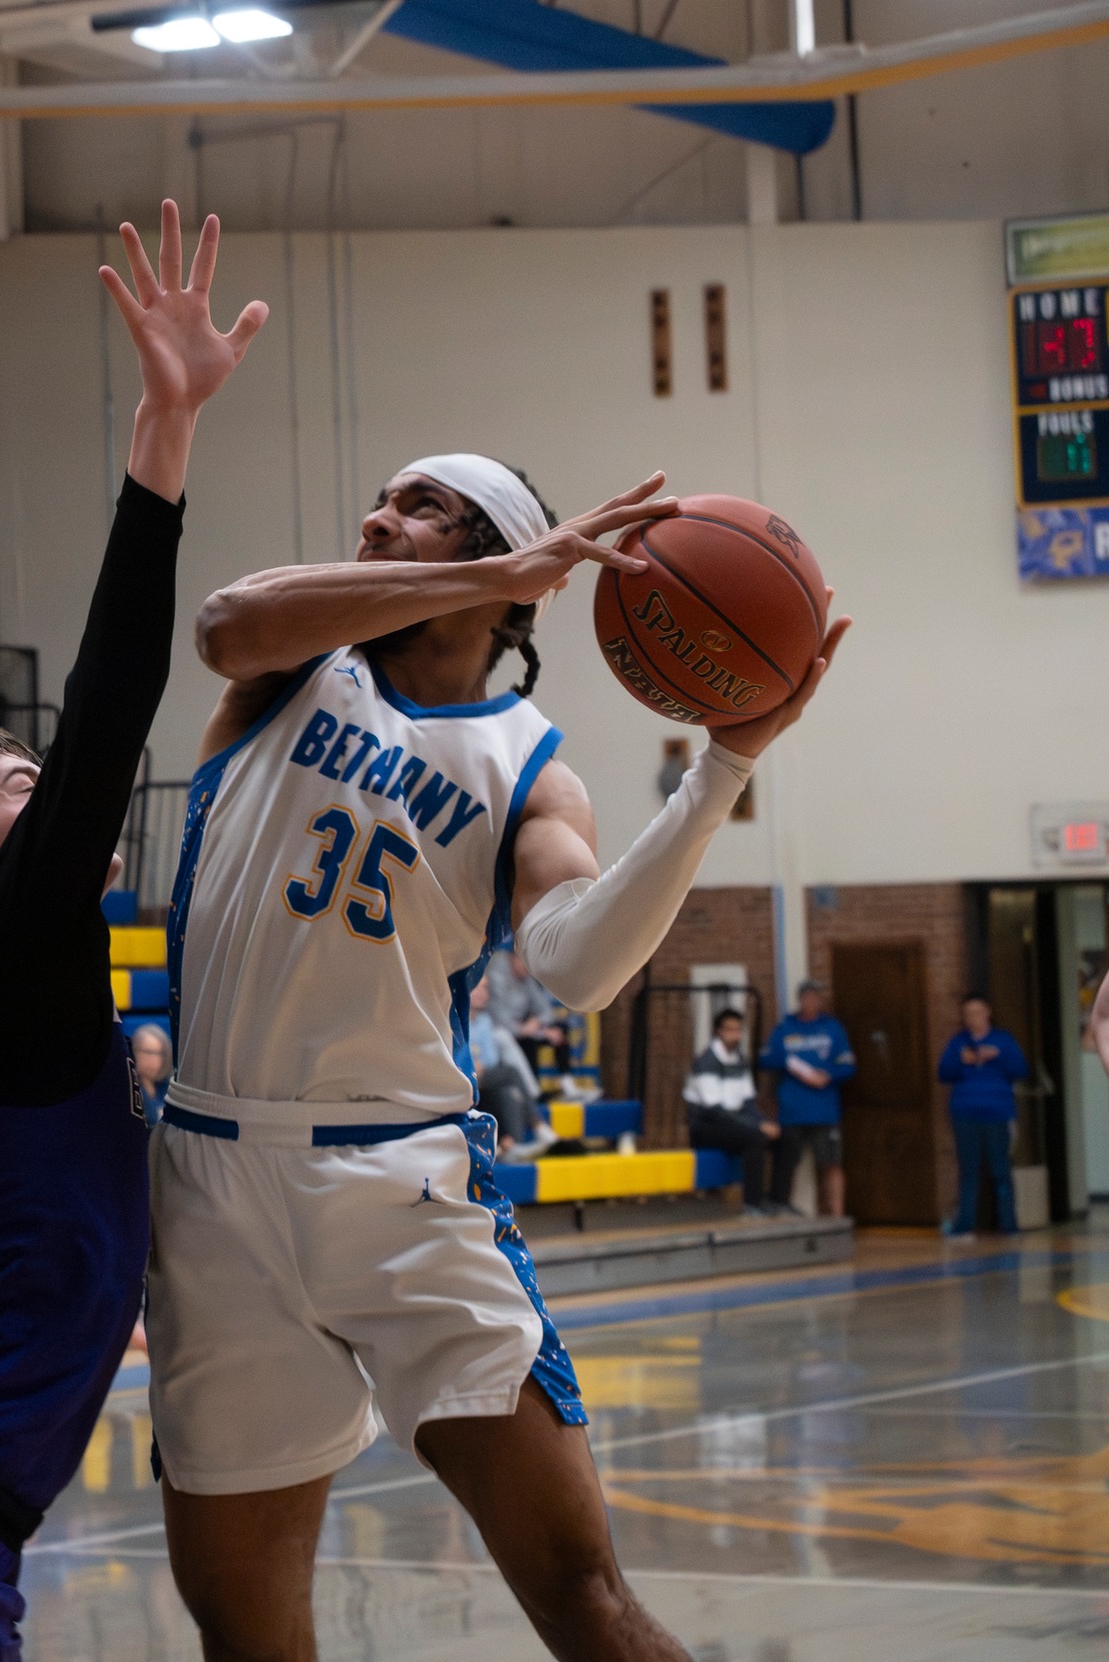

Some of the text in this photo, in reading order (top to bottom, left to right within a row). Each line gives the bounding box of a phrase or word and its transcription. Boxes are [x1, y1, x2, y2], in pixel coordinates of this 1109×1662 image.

[1018, 292, 1100, 322] HOME
[632, 589, 766, 709] SPALDING
[289, 708, 487, 849] BETHANY
[281, 803, 422, 945] 35
